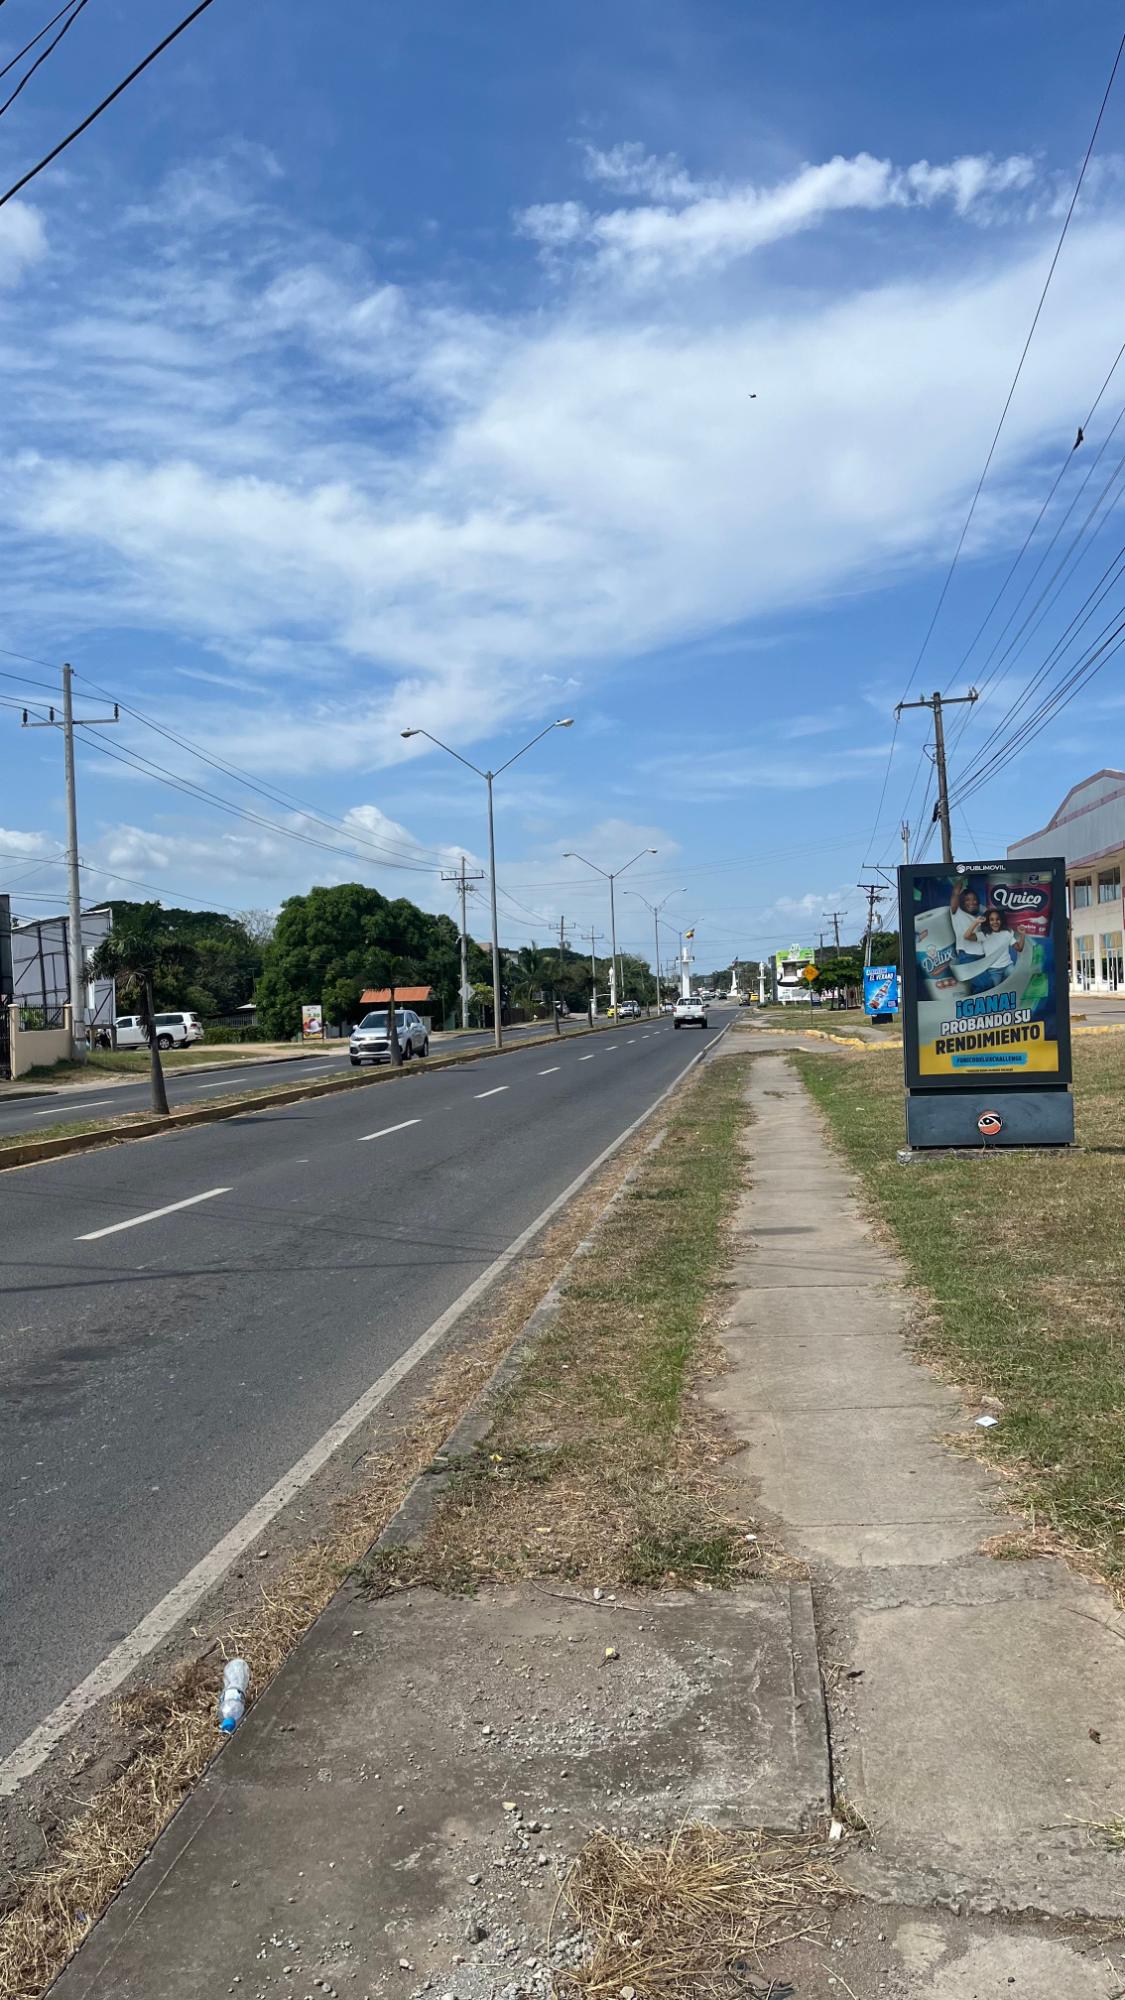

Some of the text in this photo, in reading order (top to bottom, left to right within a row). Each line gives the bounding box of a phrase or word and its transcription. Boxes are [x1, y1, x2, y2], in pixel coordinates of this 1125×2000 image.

[993, 888, 1042, 910] Unico
[922, 948, 953, 972] Delux
[956, 992, 1017, 1019] ¡GANA!
[941, 1007, 1031, 1036] PROBANDO SU
[935, 1024, 1040, 1055] RENDIMIENTO
